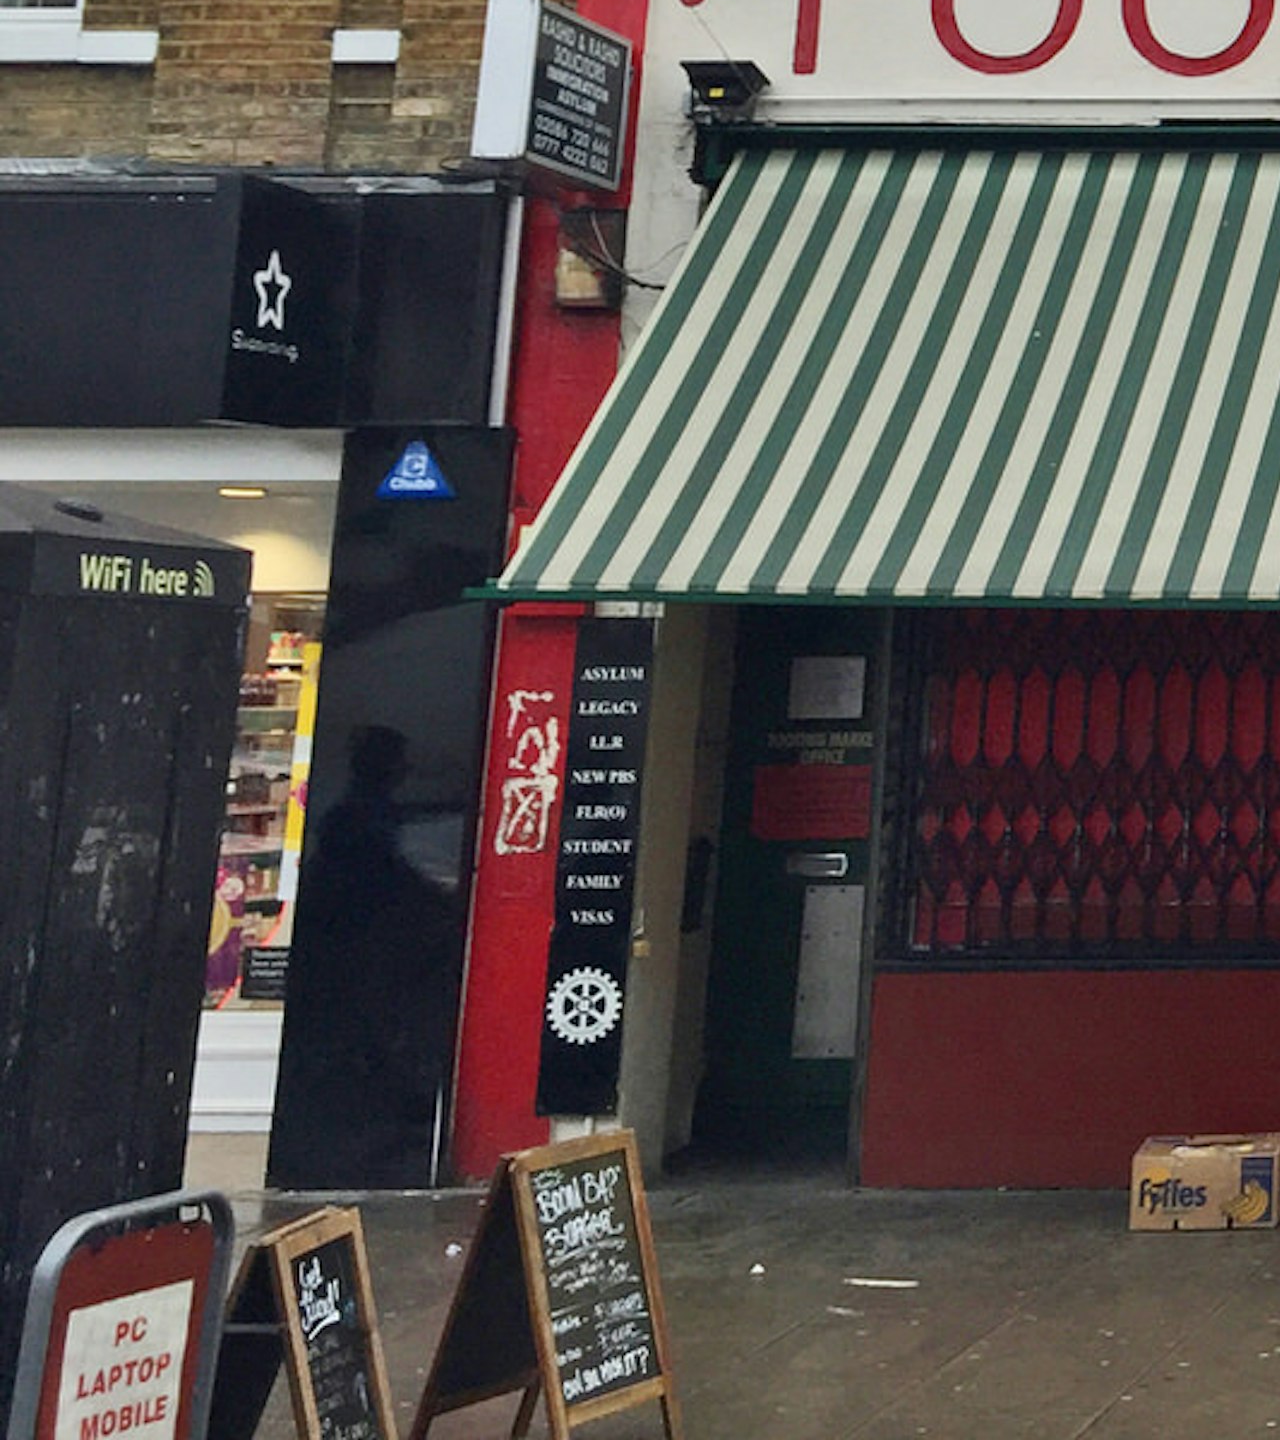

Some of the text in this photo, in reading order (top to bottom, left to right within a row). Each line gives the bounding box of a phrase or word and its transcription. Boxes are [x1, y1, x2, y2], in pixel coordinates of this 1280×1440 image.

[80, 553, 188, 596] WiFi here
[580, 666, 645, 681] ASYLUM
[578, 699, 641, 715] LEGACY
[571, 768, 637, 784] NEW PBS
[562, 839, 632, 854] STUDENT
[565, 874, 624, 890] FAMILY
[569, 909, 614, 925] VISAS
[114, 1316, 148, 1348] PC
[76, 1352, 172, 1401] LAPTOP
[79, 1395, 169, 1440] MOBILE
